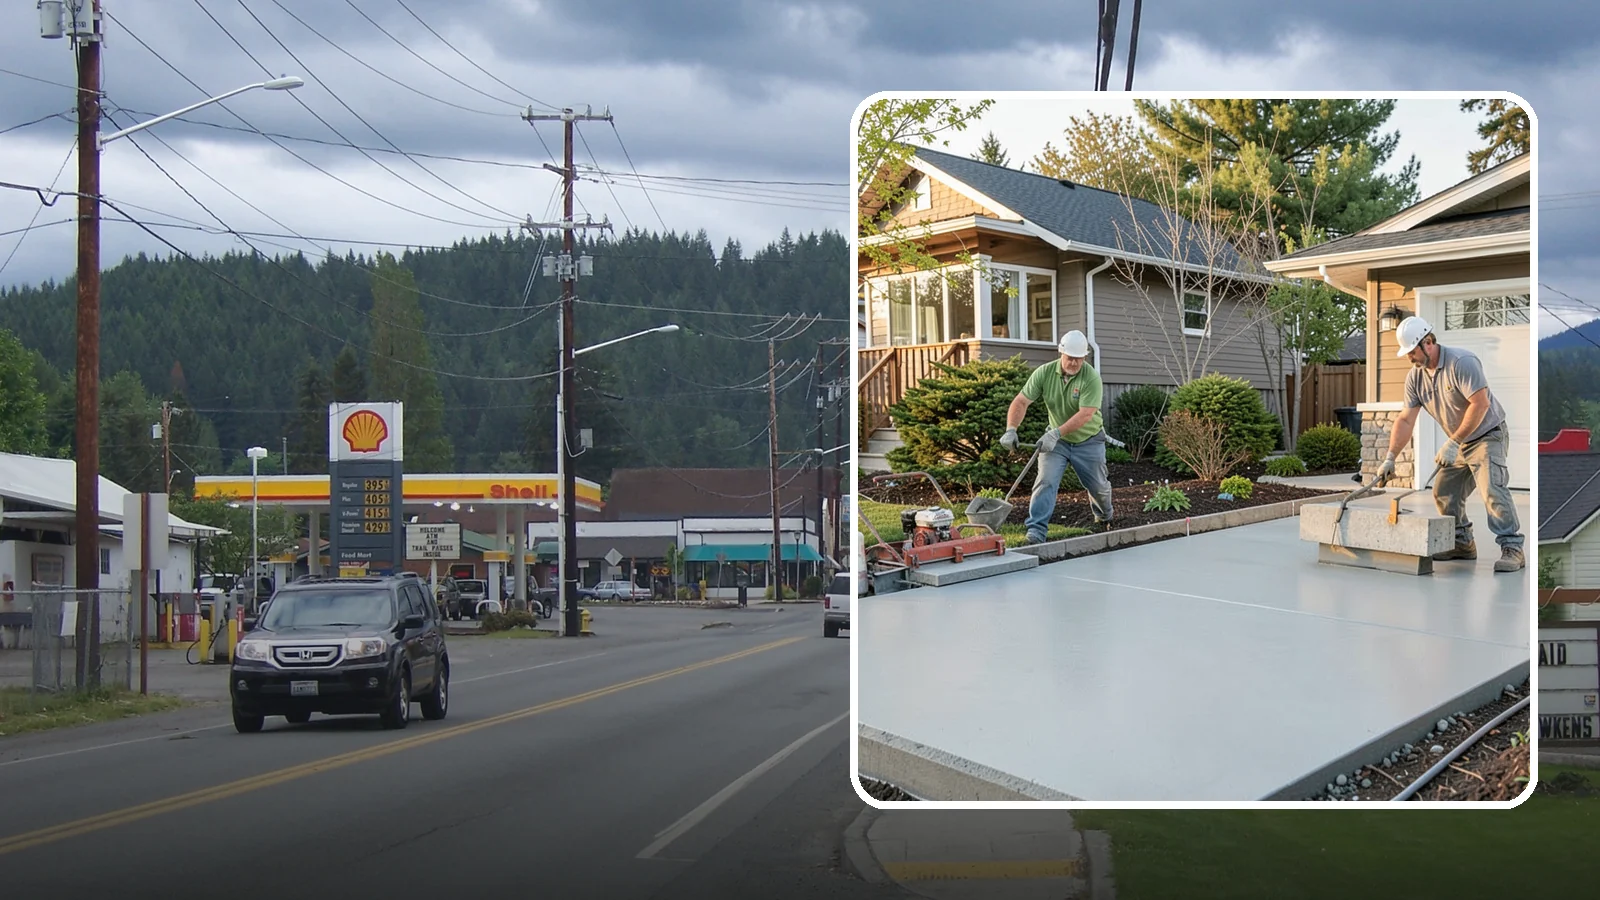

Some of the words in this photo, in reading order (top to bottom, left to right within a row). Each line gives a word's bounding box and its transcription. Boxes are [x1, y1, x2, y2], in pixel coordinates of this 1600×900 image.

[366, 480, 383, 490] 395
[490, 484, 547, 499] Shell
[366, 494, 383, 504] 405
[366, 508, 383, 518] 415
[366, 522, 383, 532] 429
